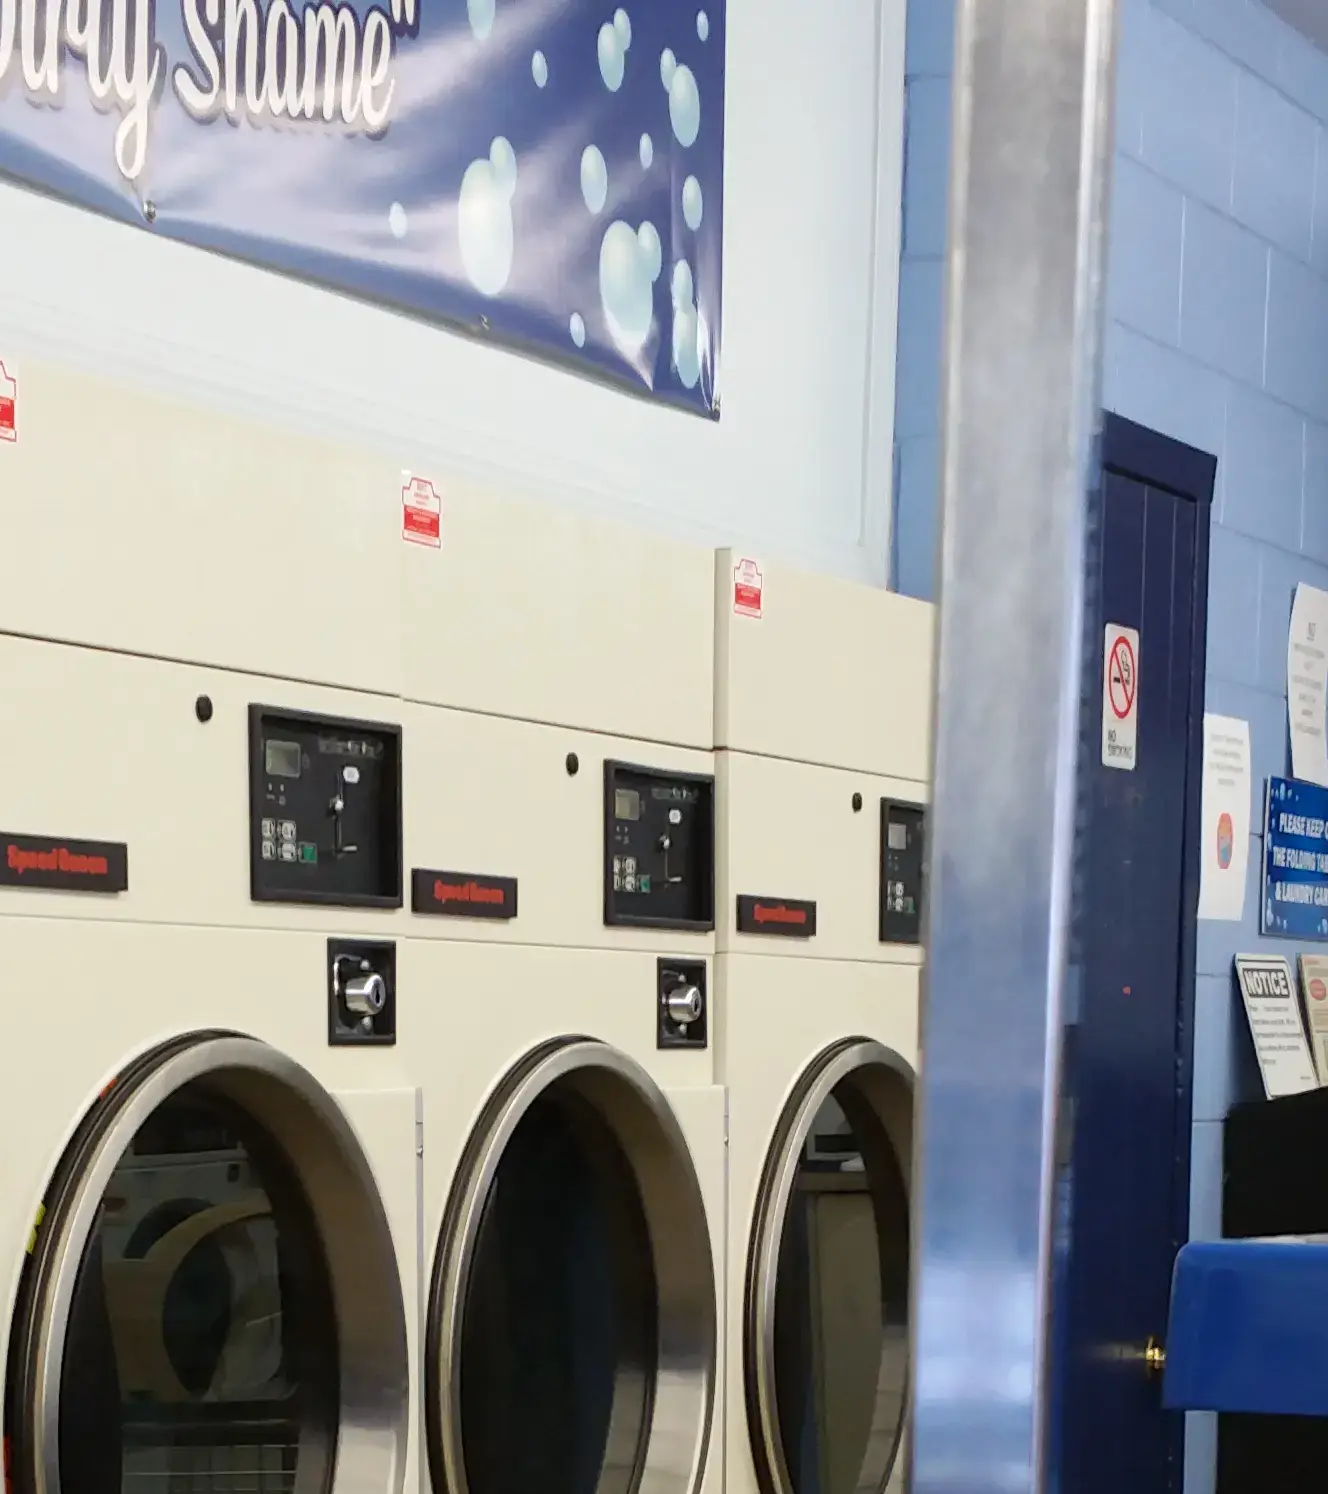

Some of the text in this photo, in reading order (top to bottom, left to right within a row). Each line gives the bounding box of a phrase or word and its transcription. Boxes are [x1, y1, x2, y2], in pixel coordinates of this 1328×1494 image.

[1279, 813, 1306, 838] PLEASE
[1306, 817, 1325, 839] KEEP
[1273, 845, 1286, 867] THE
[1286, 848, 1317, 872] FOLDING
[1282, 882, 1315, 904] LAUNDRY
[1243, 970, 1289, 996] NOTICE
